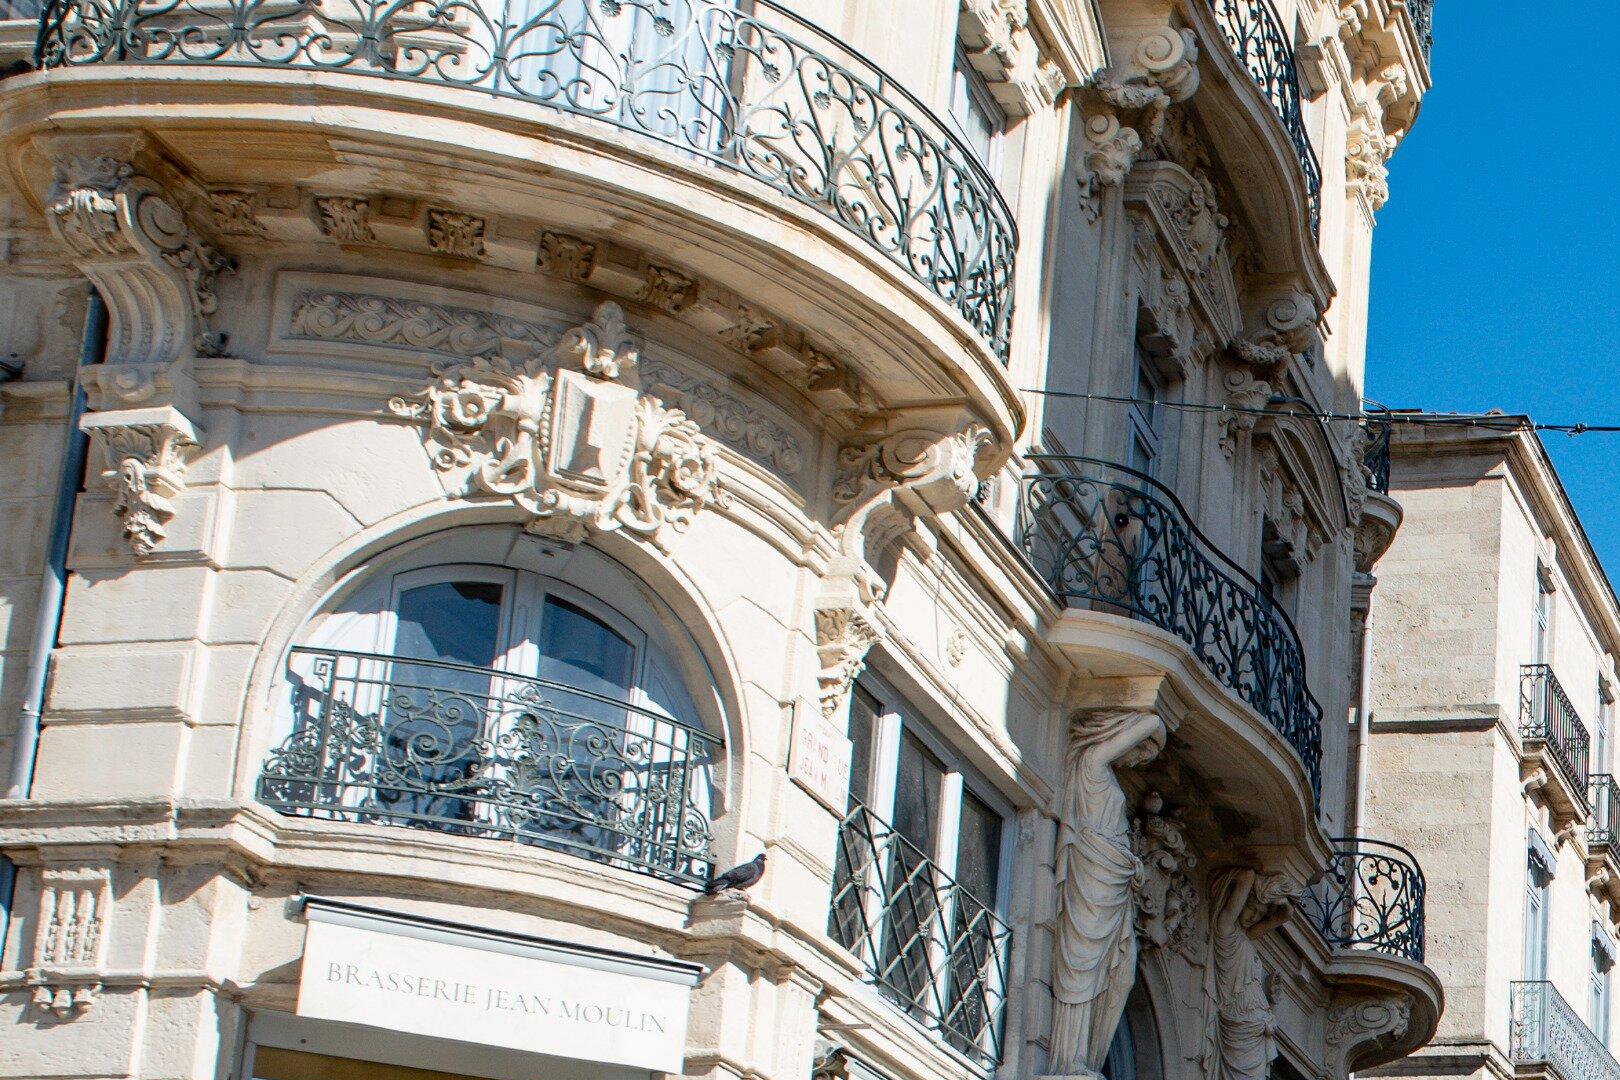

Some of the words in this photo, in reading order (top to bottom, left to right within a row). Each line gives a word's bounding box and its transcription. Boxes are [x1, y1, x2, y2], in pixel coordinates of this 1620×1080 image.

[327, 961, 477, 1004] BRASSERIE
[483, 988, 551, 1016] JEAN
[558, 1000, 667, 1034] MOULIN
